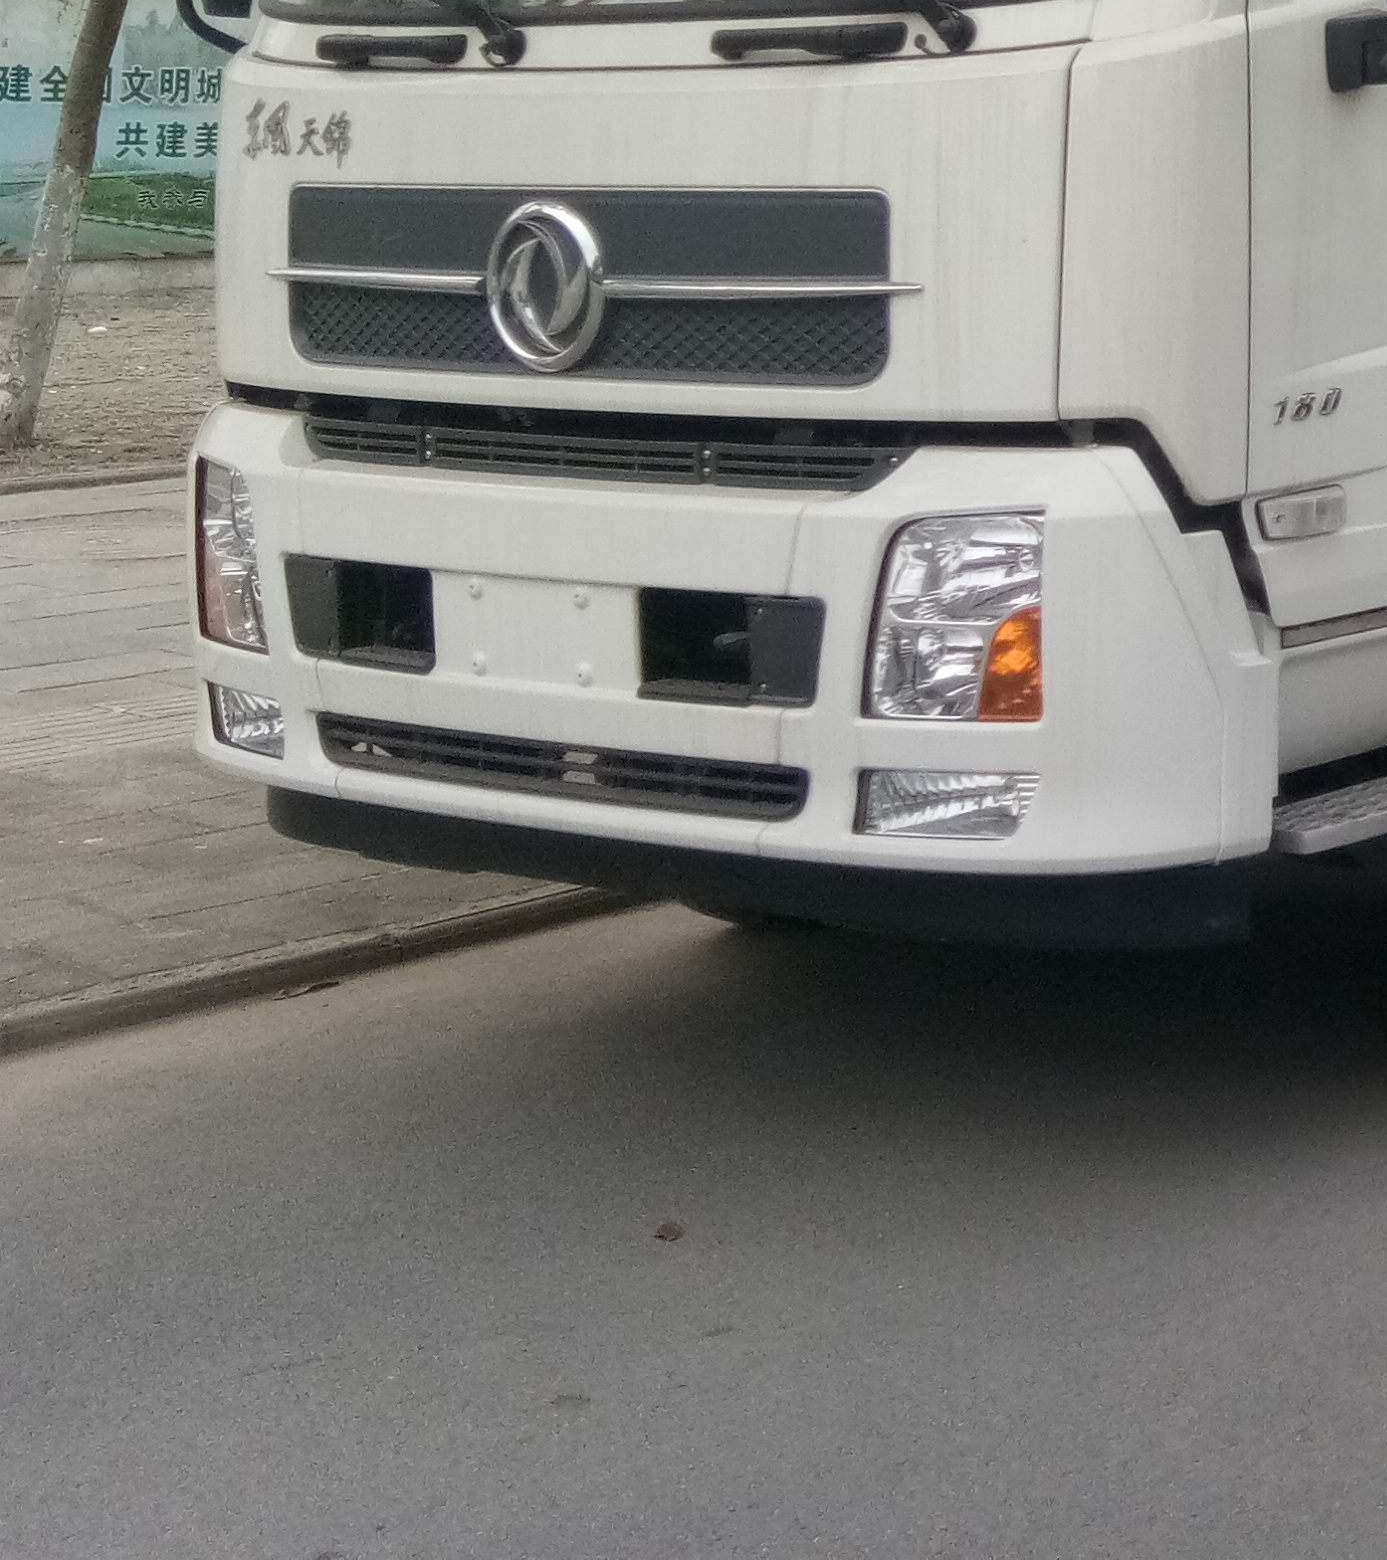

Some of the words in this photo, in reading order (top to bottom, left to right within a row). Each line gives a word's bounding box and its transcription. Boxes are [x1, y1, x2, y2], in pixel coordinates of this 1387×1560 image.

[0, 64, 224, 104] 建全文明城
[1273, 387, 1343, 426] 180
